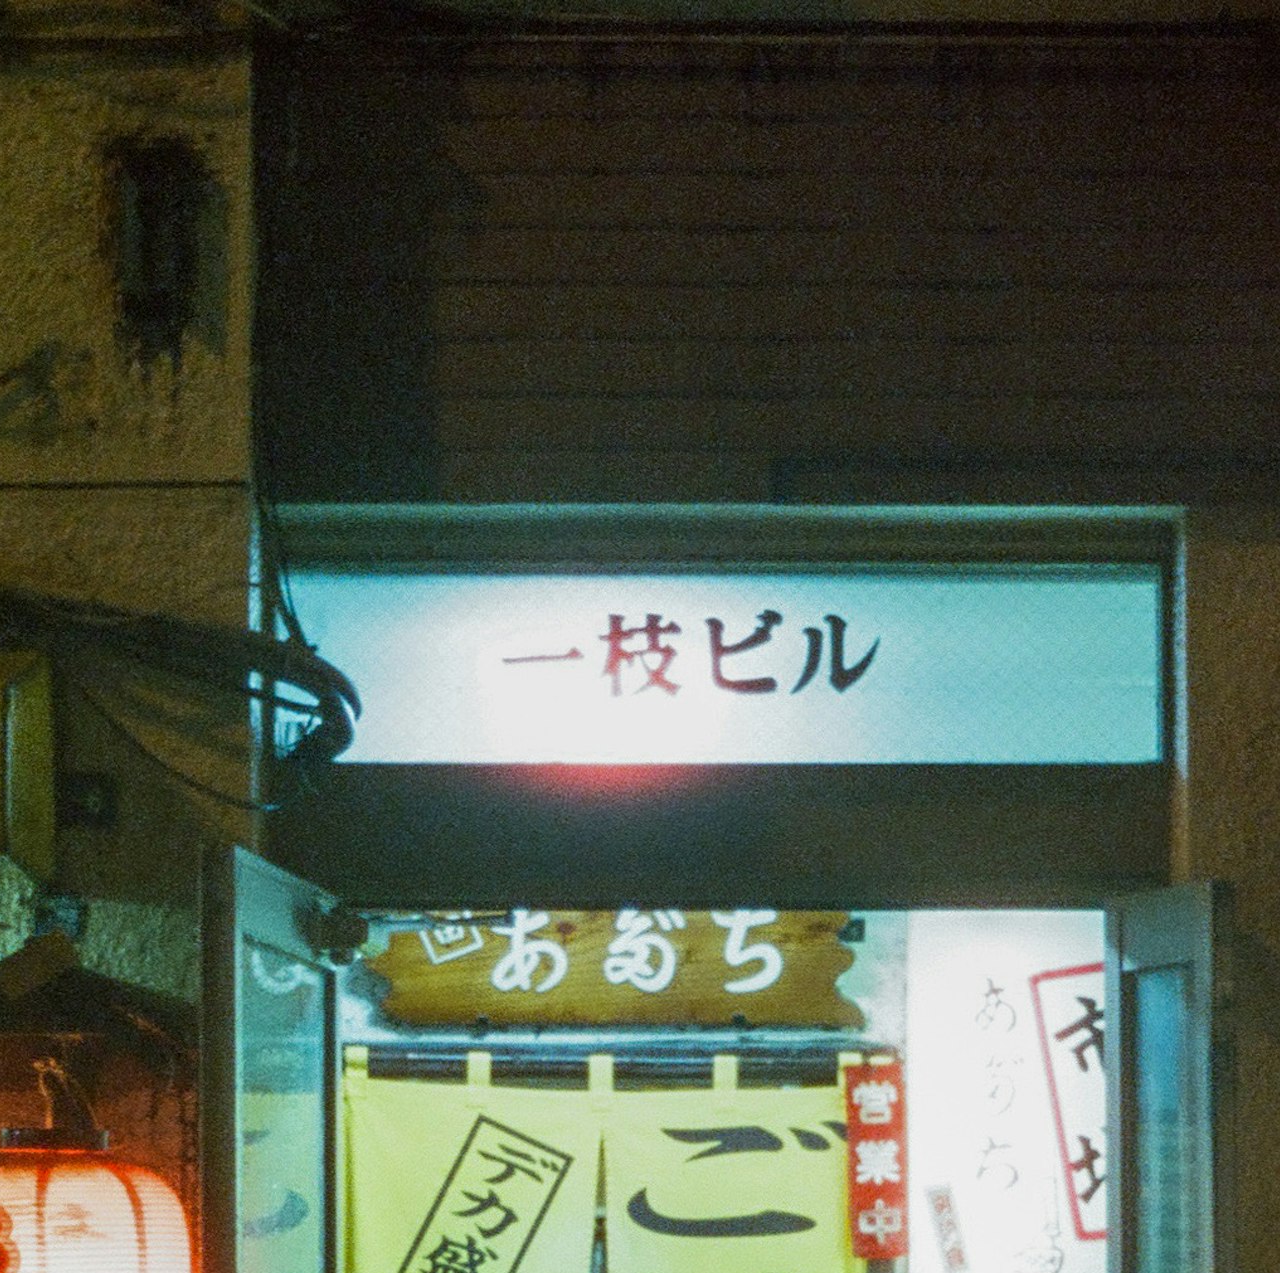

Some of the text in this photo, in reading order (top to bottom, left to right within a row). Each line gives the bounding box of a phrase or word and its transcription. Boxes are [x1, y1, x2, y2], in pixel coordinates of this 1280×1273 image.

[500, 608, 882, 698] 一枝ビル
[851, 1079, 904, 1244] 営業中
